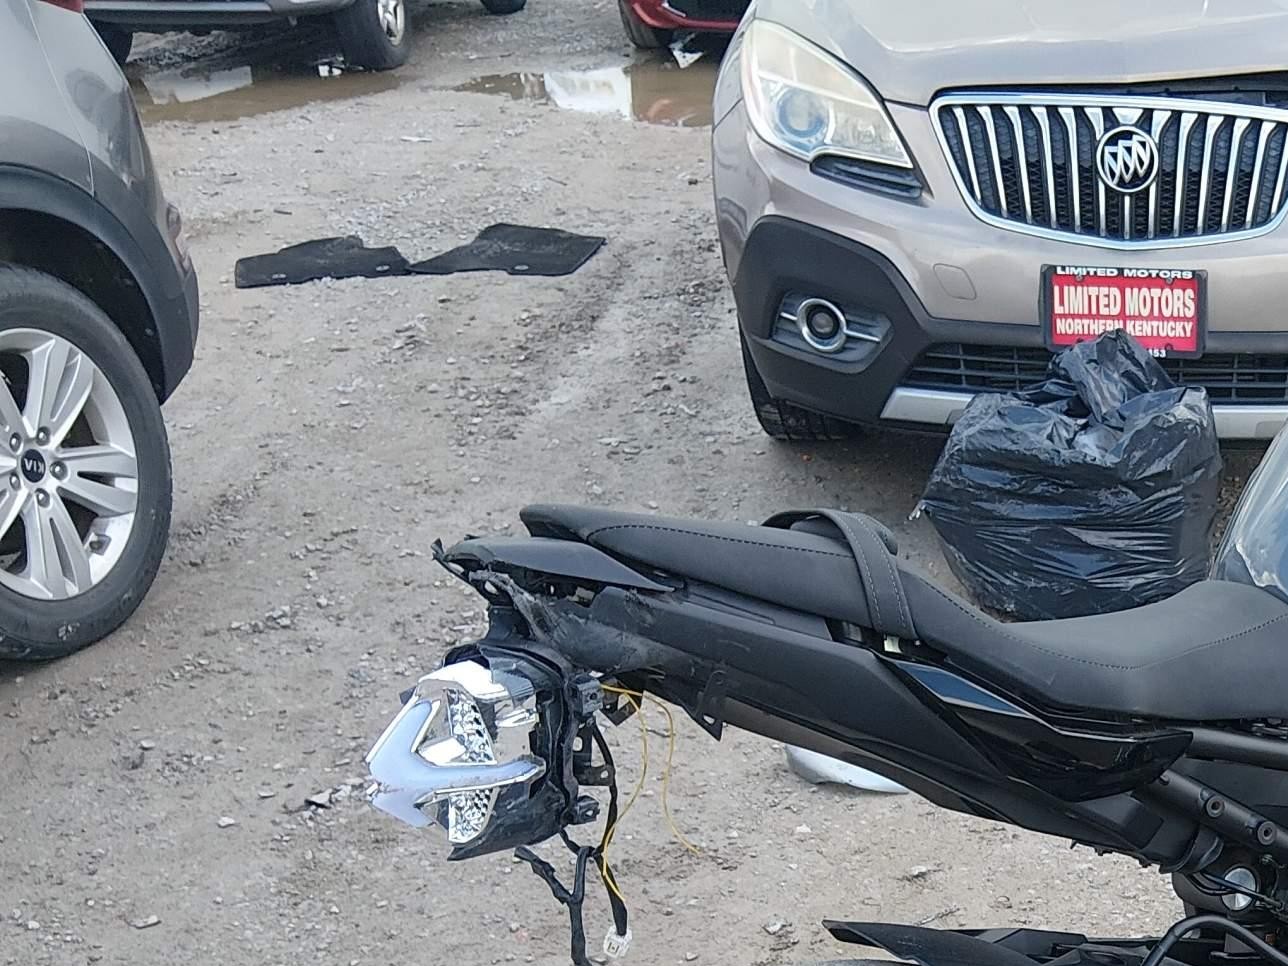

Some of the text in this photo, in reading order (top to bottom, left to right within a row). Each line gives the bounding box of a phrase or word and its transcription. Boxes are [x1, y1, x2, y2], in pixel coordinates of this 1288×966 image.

[1056, 266, 1193, 279] LIMITED MOTORS
[1053, 285, 1195, 318] LIMITED MOTORS
[1126, 319, 1193, 337] KENTUCKY
[23, 457, 45, 474] KIA
